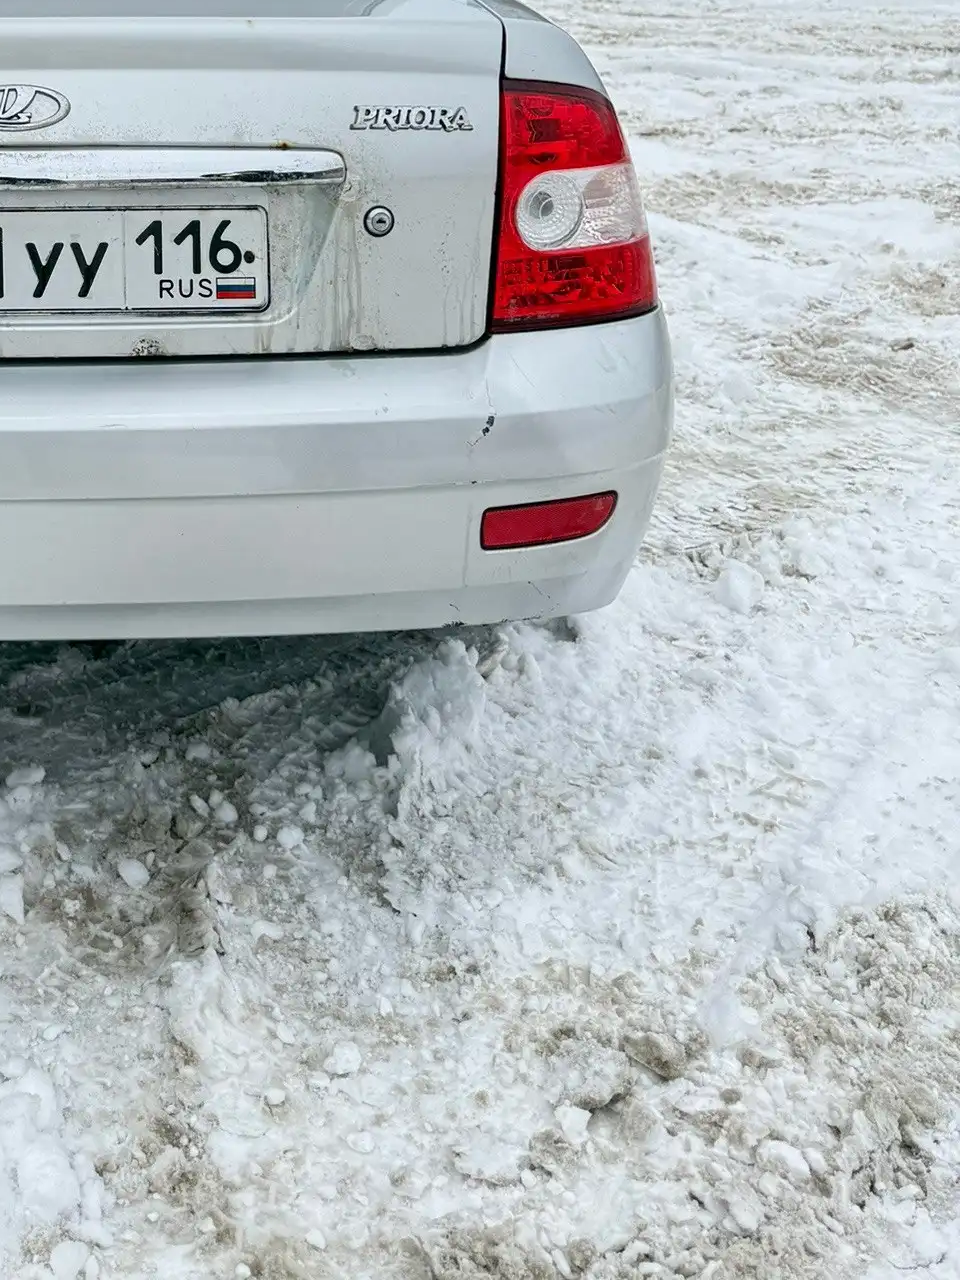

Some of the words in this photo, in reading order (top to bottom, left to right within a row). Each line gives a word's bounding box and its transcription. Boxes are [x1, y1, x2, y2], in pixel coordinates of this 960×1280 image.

[349, 106, 474, 132] PRIORA
[135, 219, 243, 275] 116
[159, 278, 213, 299] RUS
